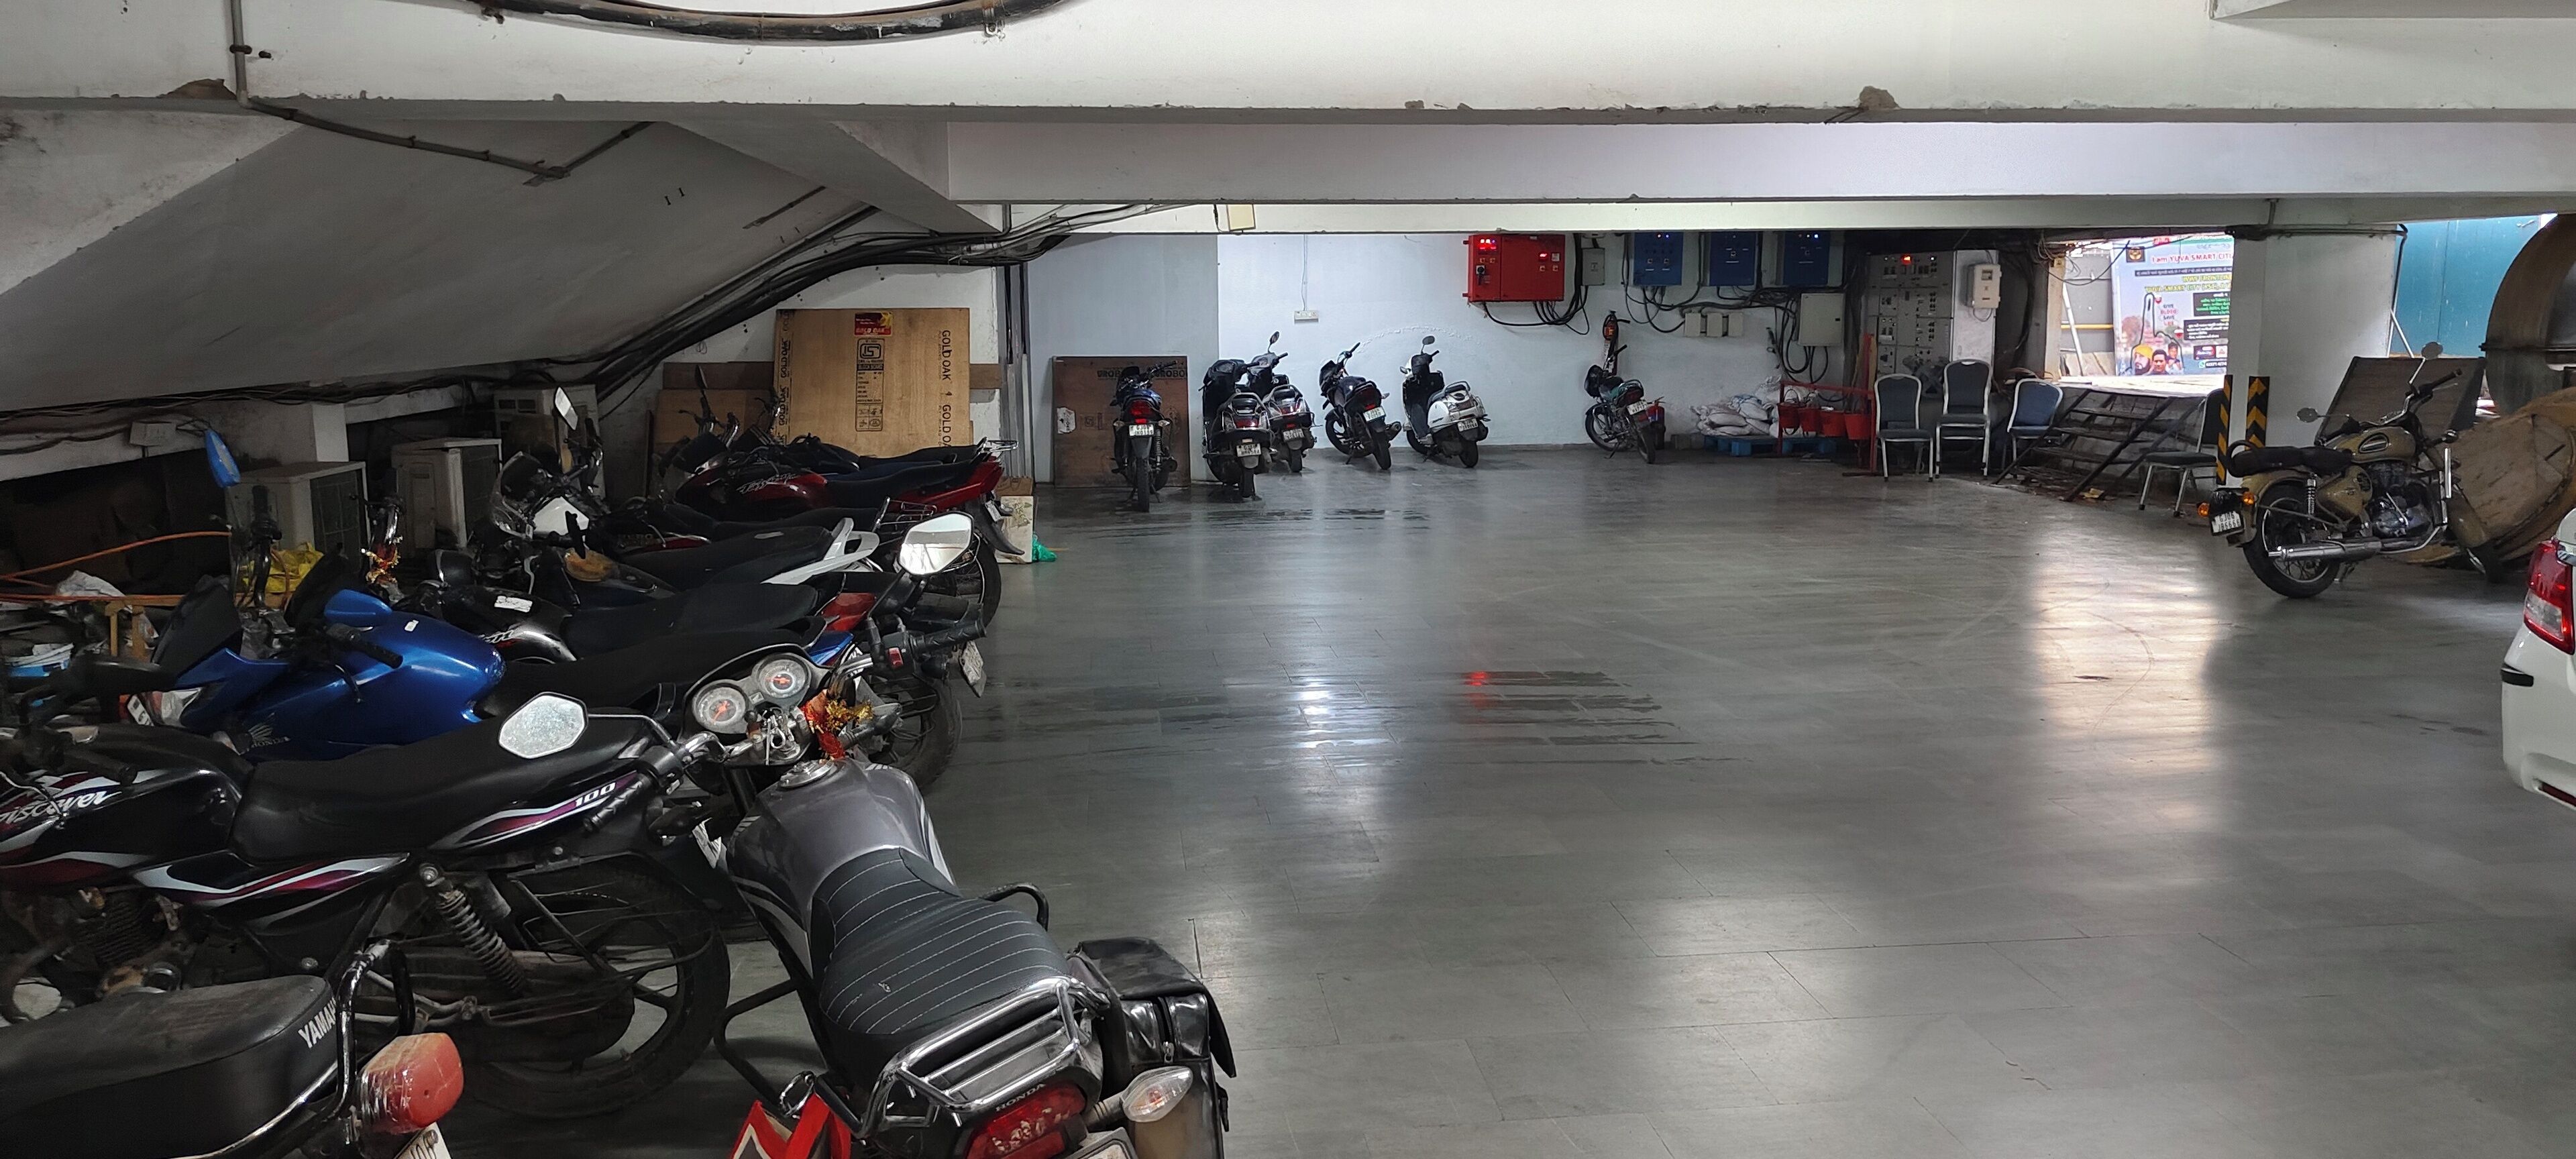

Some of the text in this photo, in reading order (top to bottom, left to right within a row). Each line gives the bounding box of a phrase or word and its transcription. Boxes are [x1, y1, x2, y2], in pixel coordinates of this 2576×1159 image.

[942, 330, 952, 380] GOLD OAK
[943, 404, 951, 447] GOLD OA
[0, 791, 123, 825] iscover
[576, 782, 616, 807] 100
[996, 1083, 1046, 1111] HONDA
